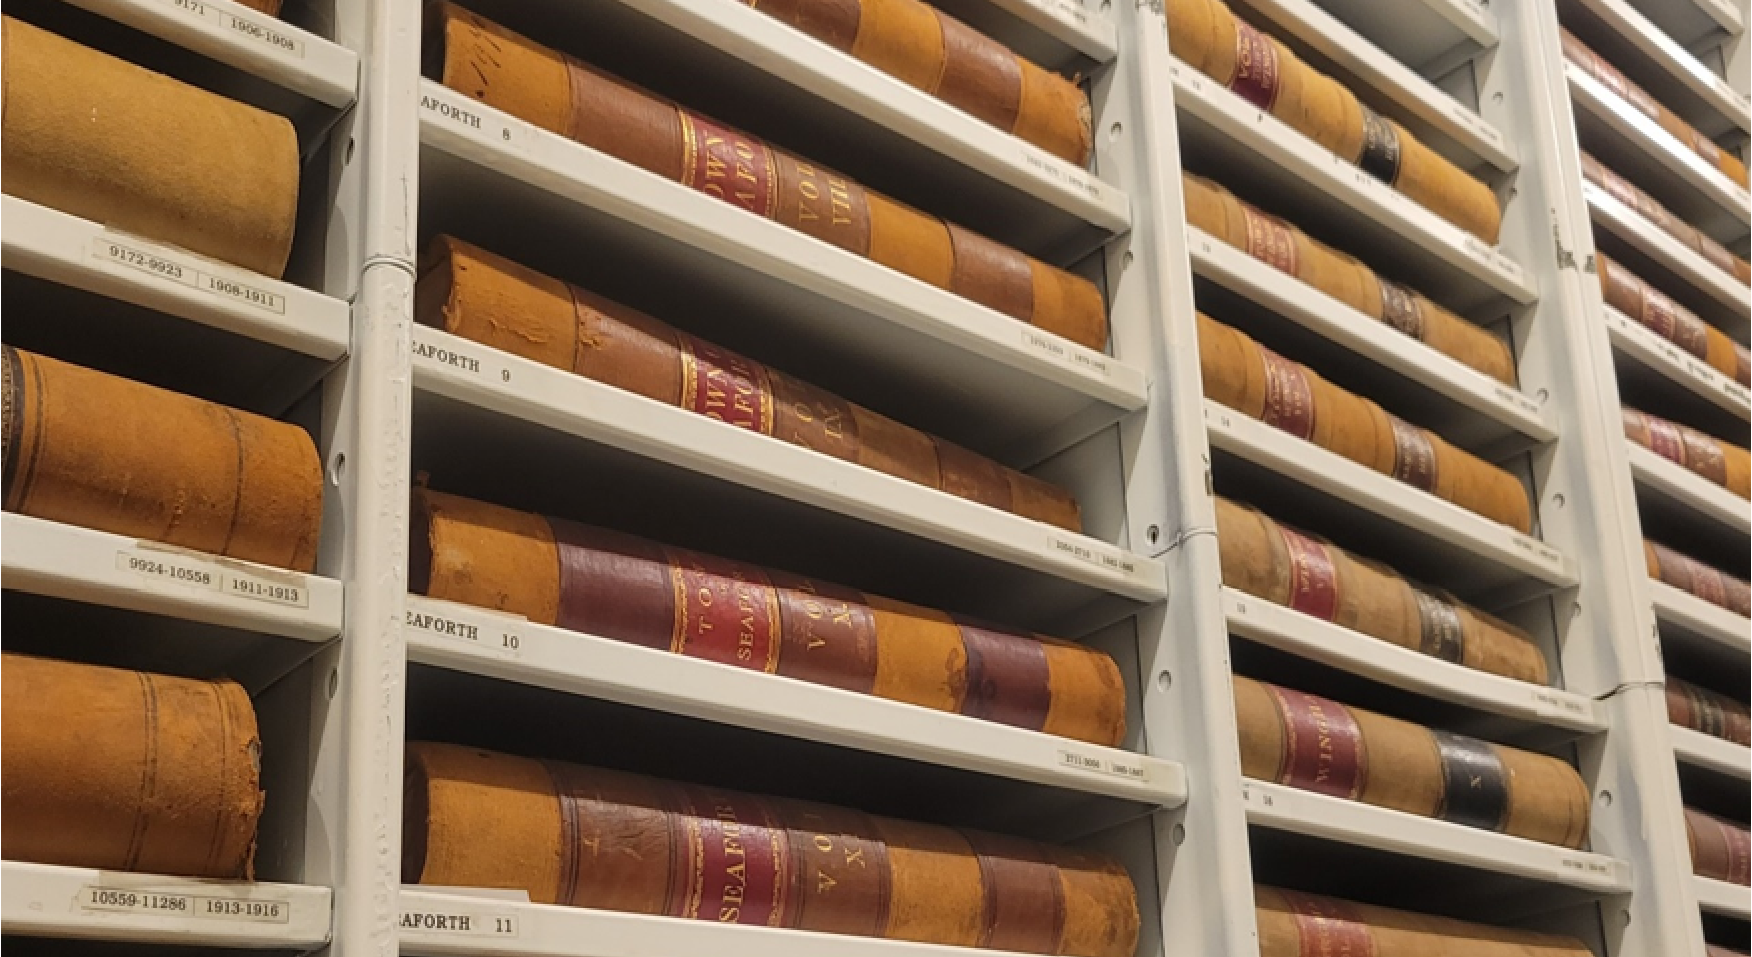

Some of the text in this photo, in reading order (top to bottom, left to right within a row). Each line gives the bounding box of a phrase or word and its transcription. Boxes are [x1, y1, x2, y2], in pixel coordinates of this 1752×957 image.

[502, 127, 512, 141] 8
[109, 245, 275, 308] 9172-9923 1908-1911
[501, 368, 511, 383] 9
[129, 556, 299, 603] 9924-10558 1911-1913
[502, 633, 520, 650] 10
[91, 890, 280, 917] 10559-11286 1913-1916
[398, 912, 513, 933] AFORTH 11
